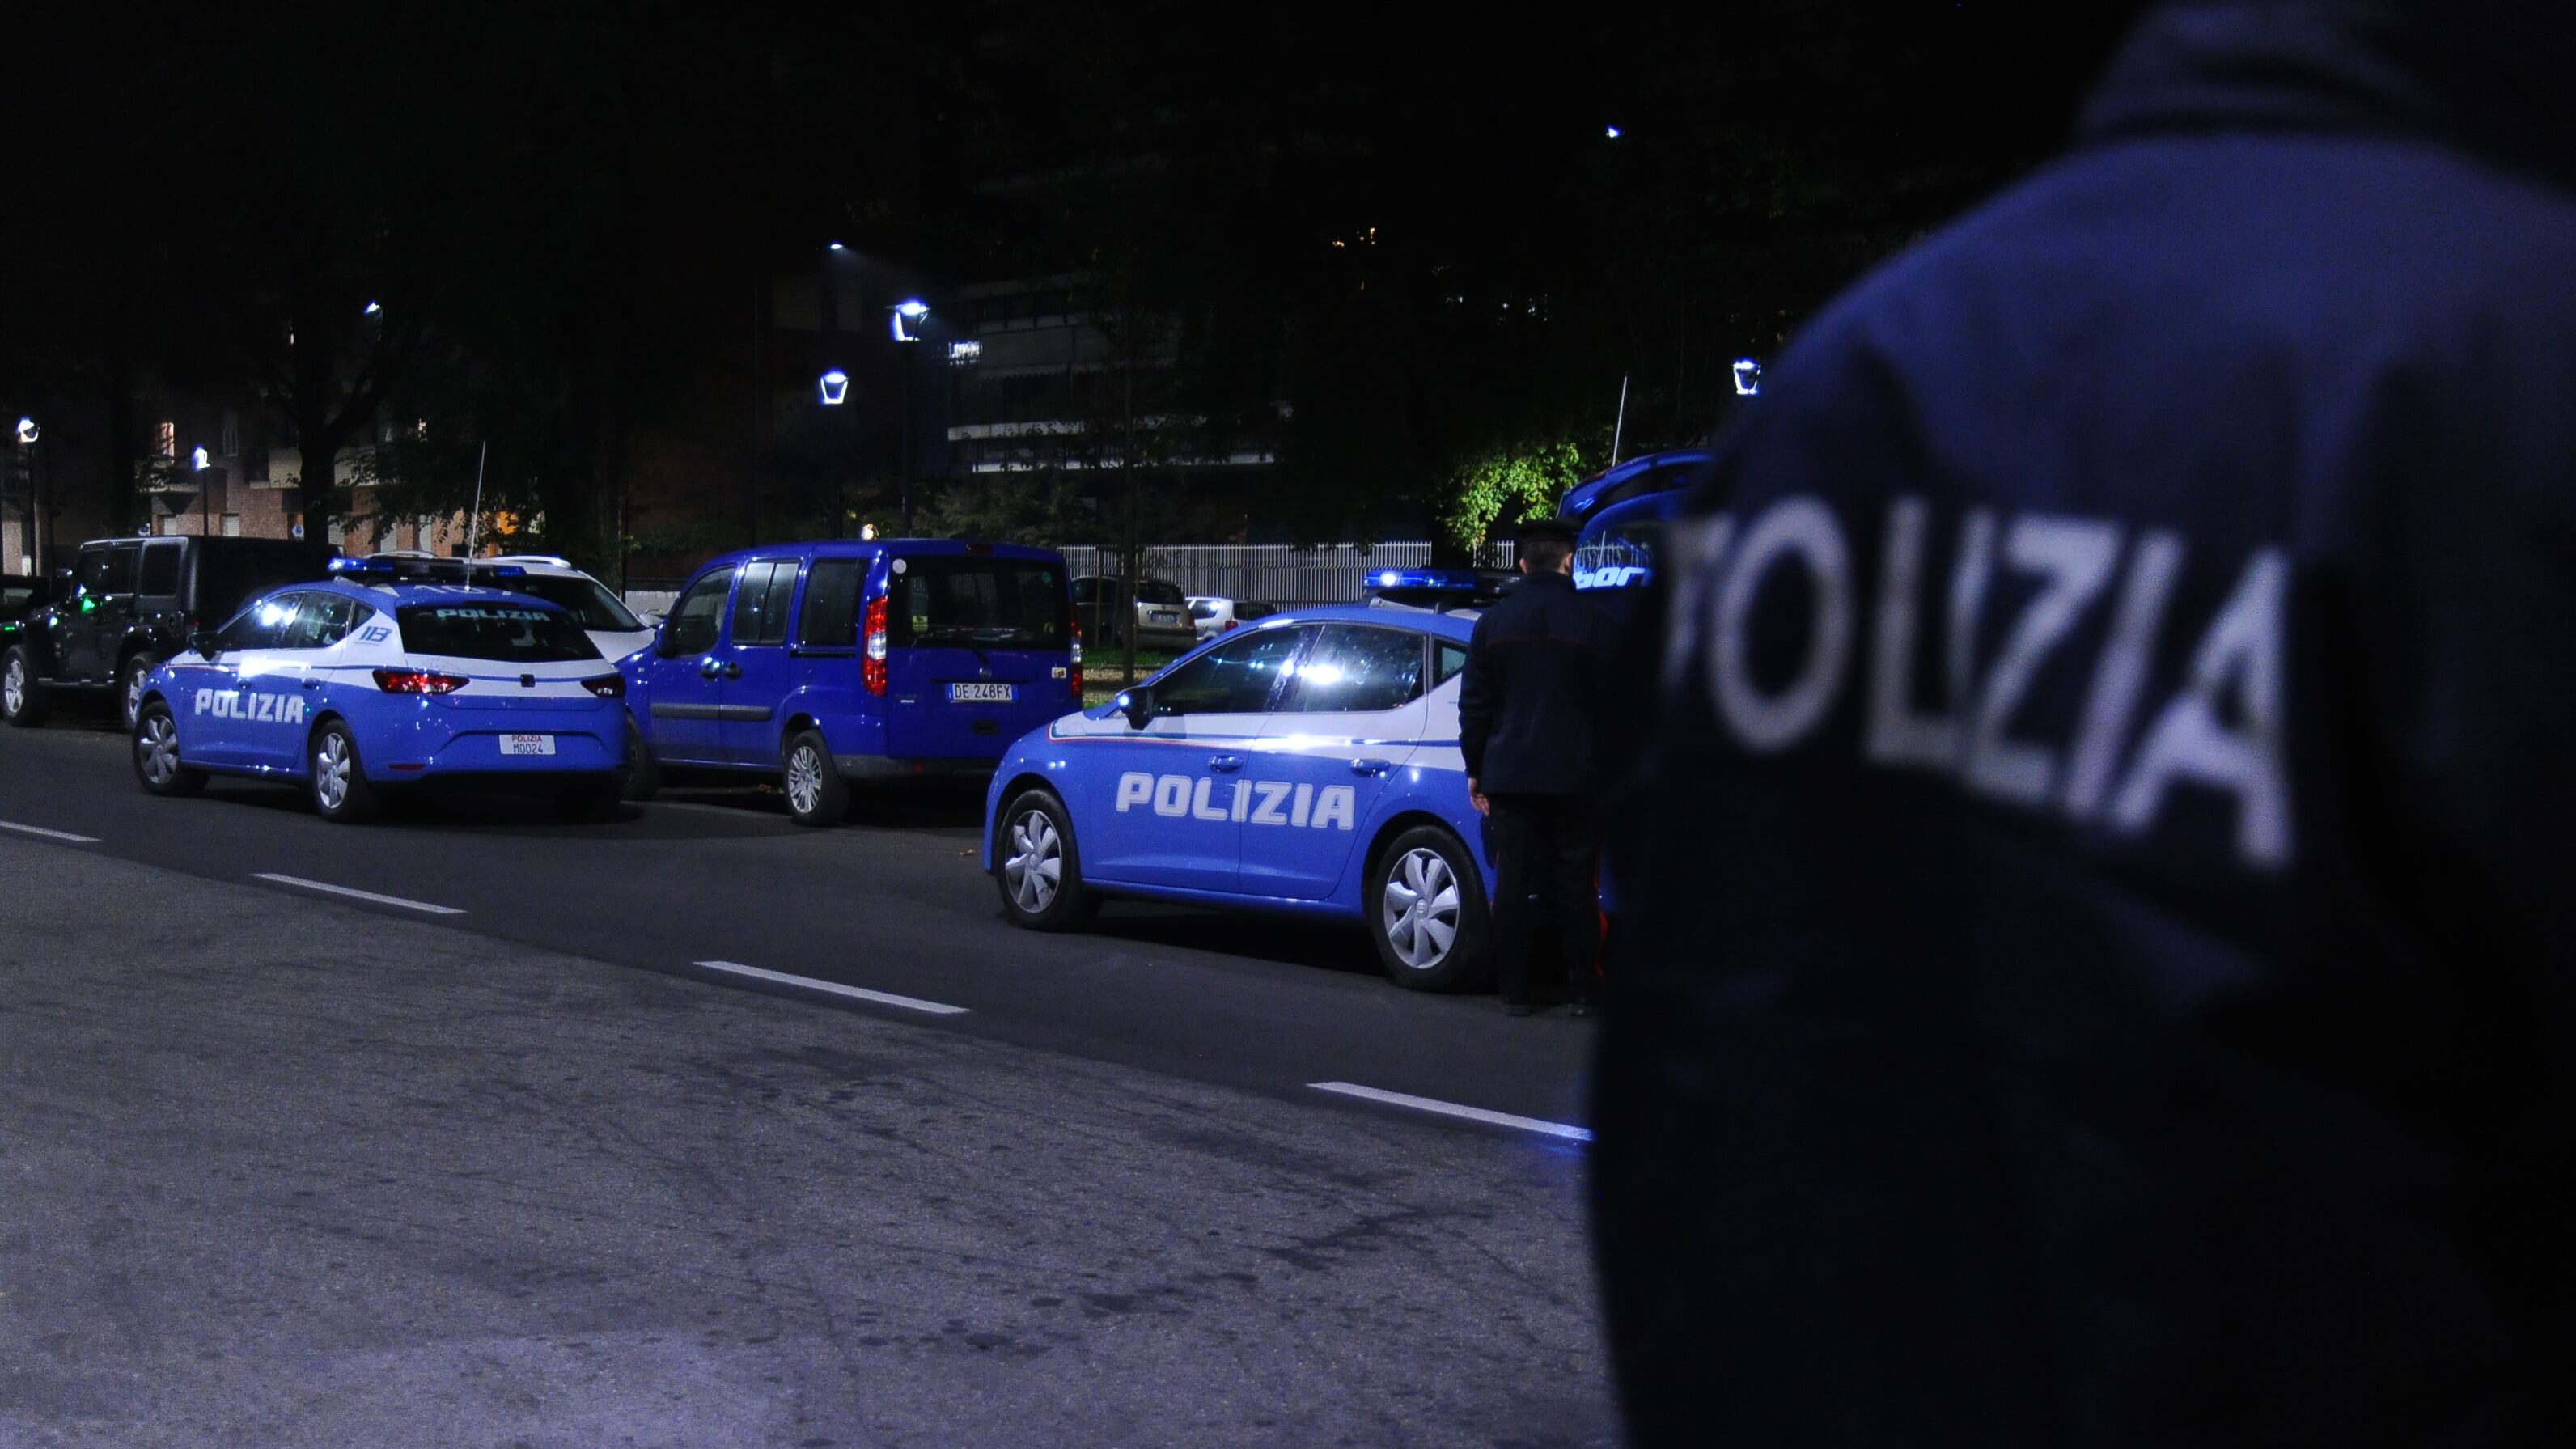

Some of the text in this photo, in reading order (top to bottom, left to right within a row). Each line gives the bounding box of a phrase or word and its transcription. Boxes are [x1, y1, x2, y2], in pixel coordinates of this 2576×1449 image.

[436, 608, 551, 621] POLIZIA
[955, 684, 1011, 699] DE 248FX
[195, 688, 304, 724] POLIZIA
[511, 735, 543, 743] POLIZIA
[513, 744, 544, 753] M0024
[1116, 772, 1356, 831] POLIZIA
